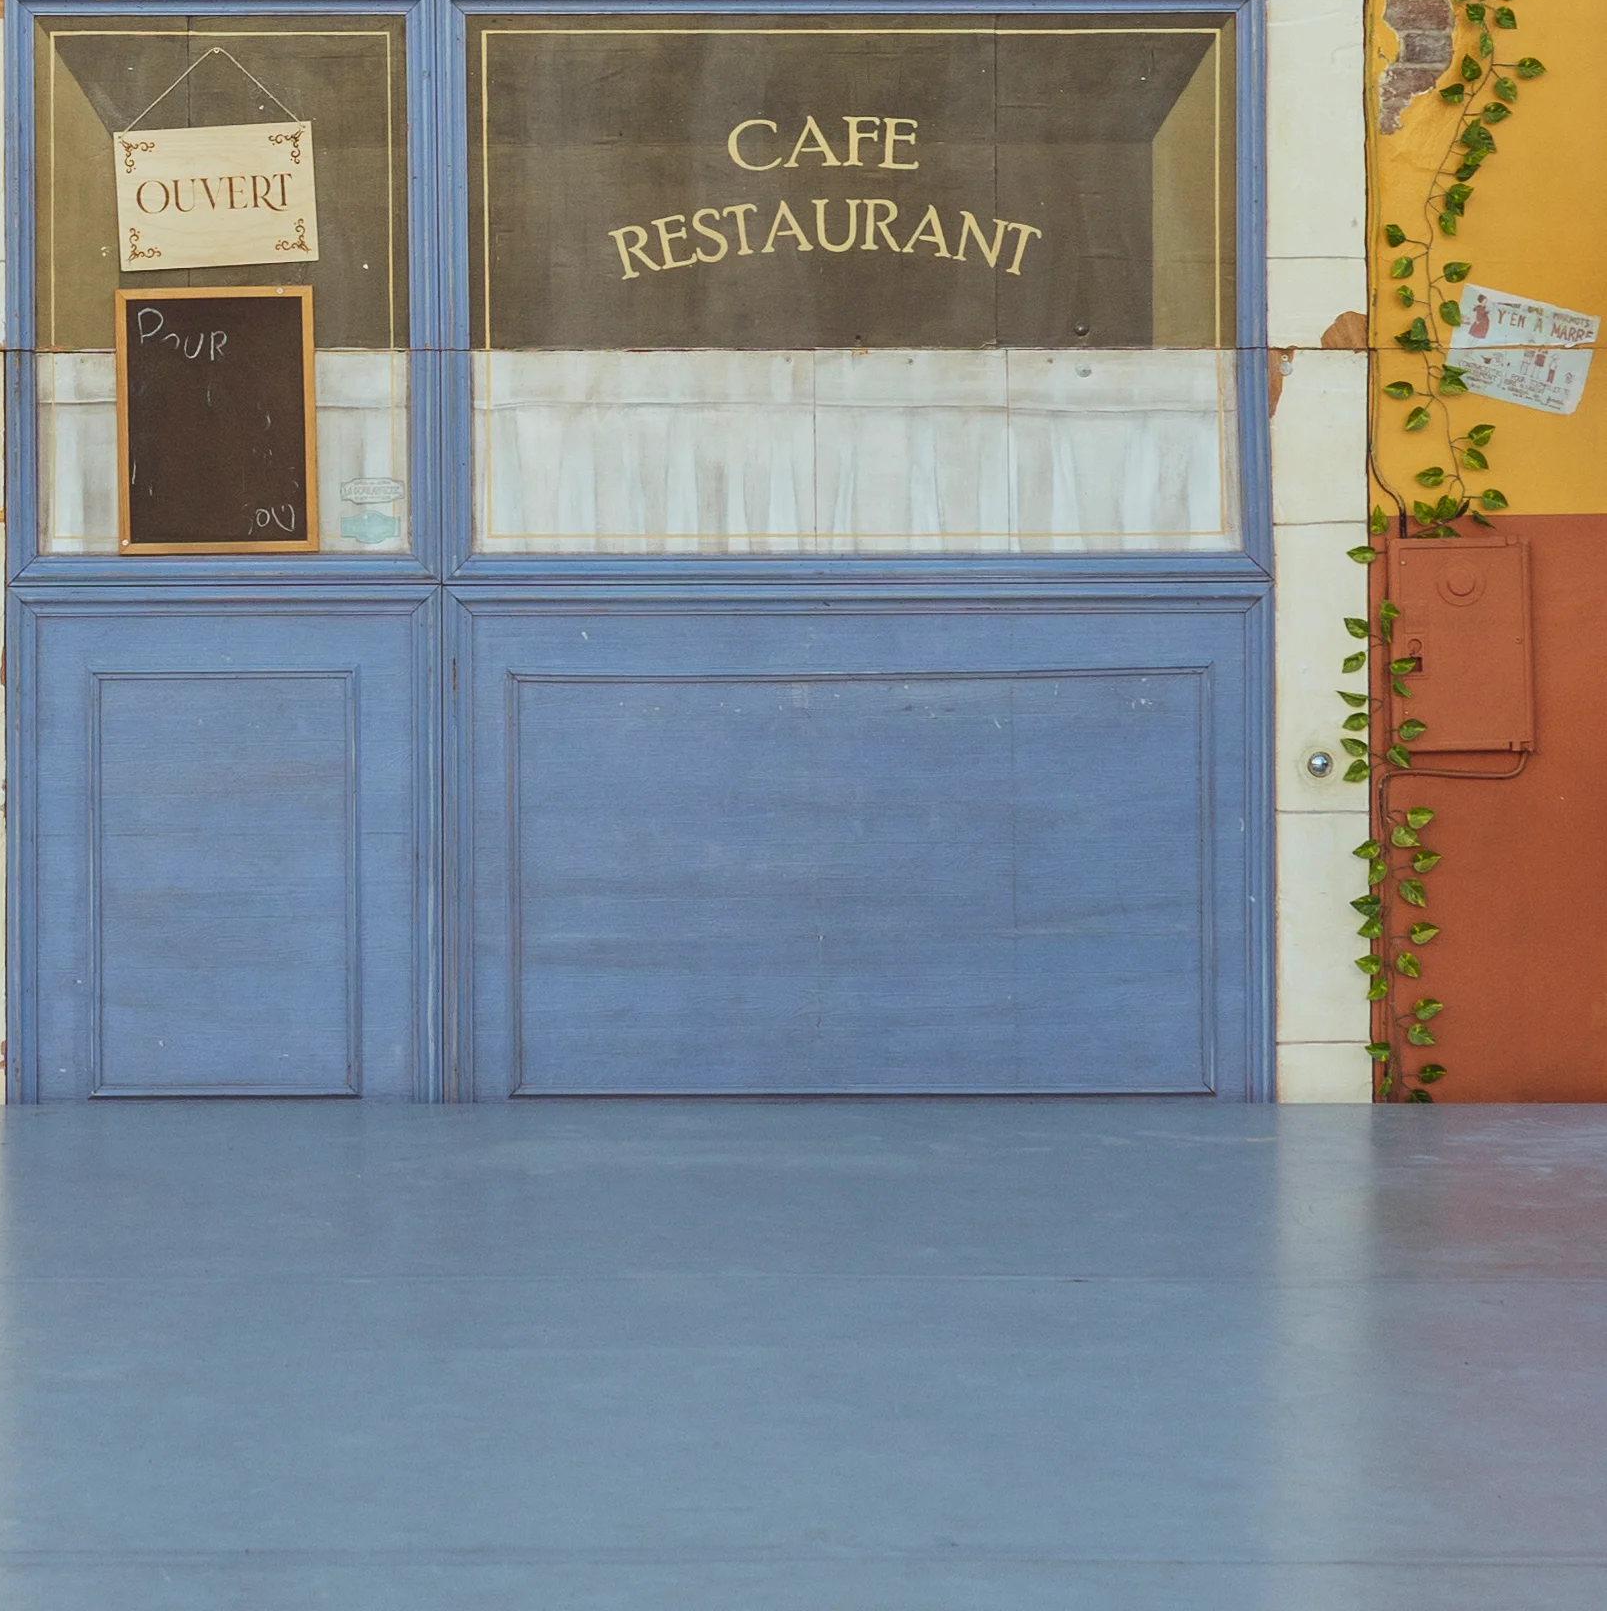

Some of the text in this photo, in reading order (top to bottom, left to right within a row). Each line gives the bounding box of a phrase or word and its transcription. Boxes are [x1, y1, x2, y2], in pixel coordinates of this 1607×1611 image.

[728, 115, 920, 172] CAFE
[136, 173, 292, 214] OUVERT
[608, 198, 1043, 281] RESTAURANT
